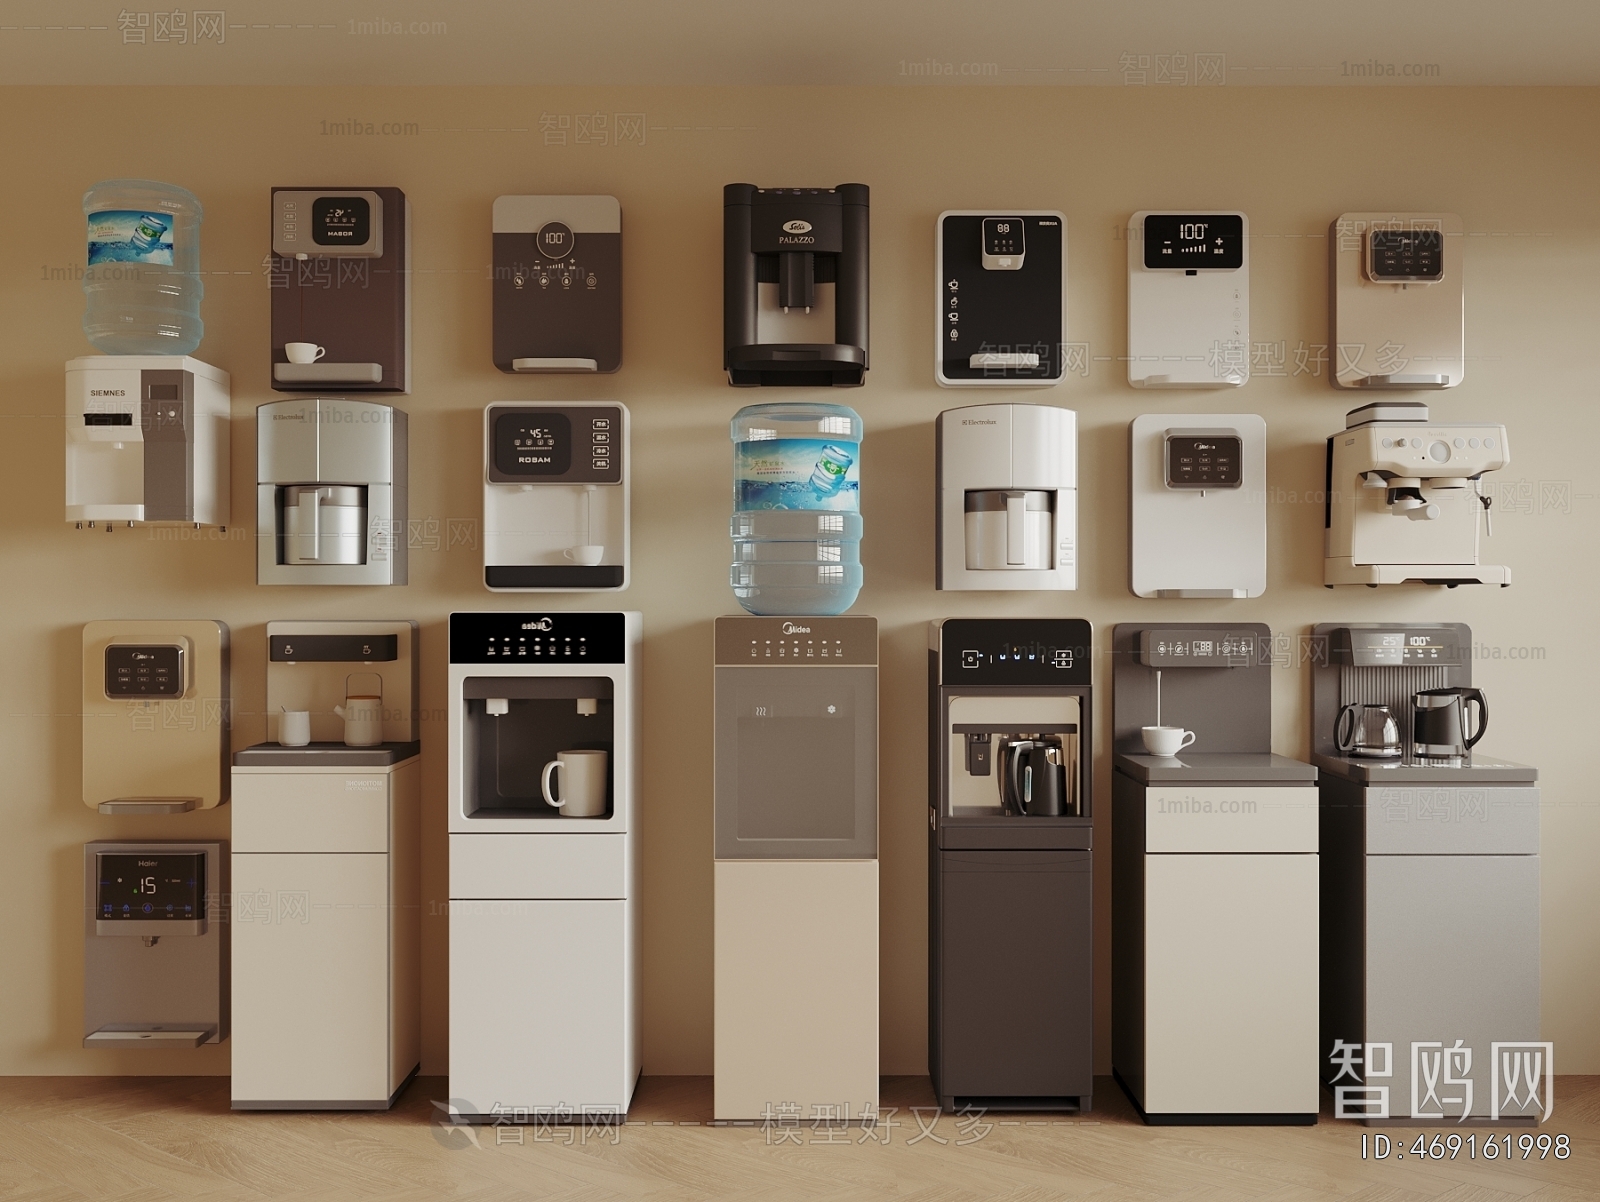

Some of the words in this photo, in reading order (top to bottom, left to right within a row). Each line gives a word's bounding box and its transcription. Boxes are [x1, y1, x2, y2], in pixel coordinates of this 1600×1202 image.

[779, 236, 815, 244] PALAZZO
[90, 389, 126, 397] SIEMNES
[968, 418, 997, 426] Electrolux
[782, 622, 811, 635] Midea
[140, 876, 157, 895] 15
